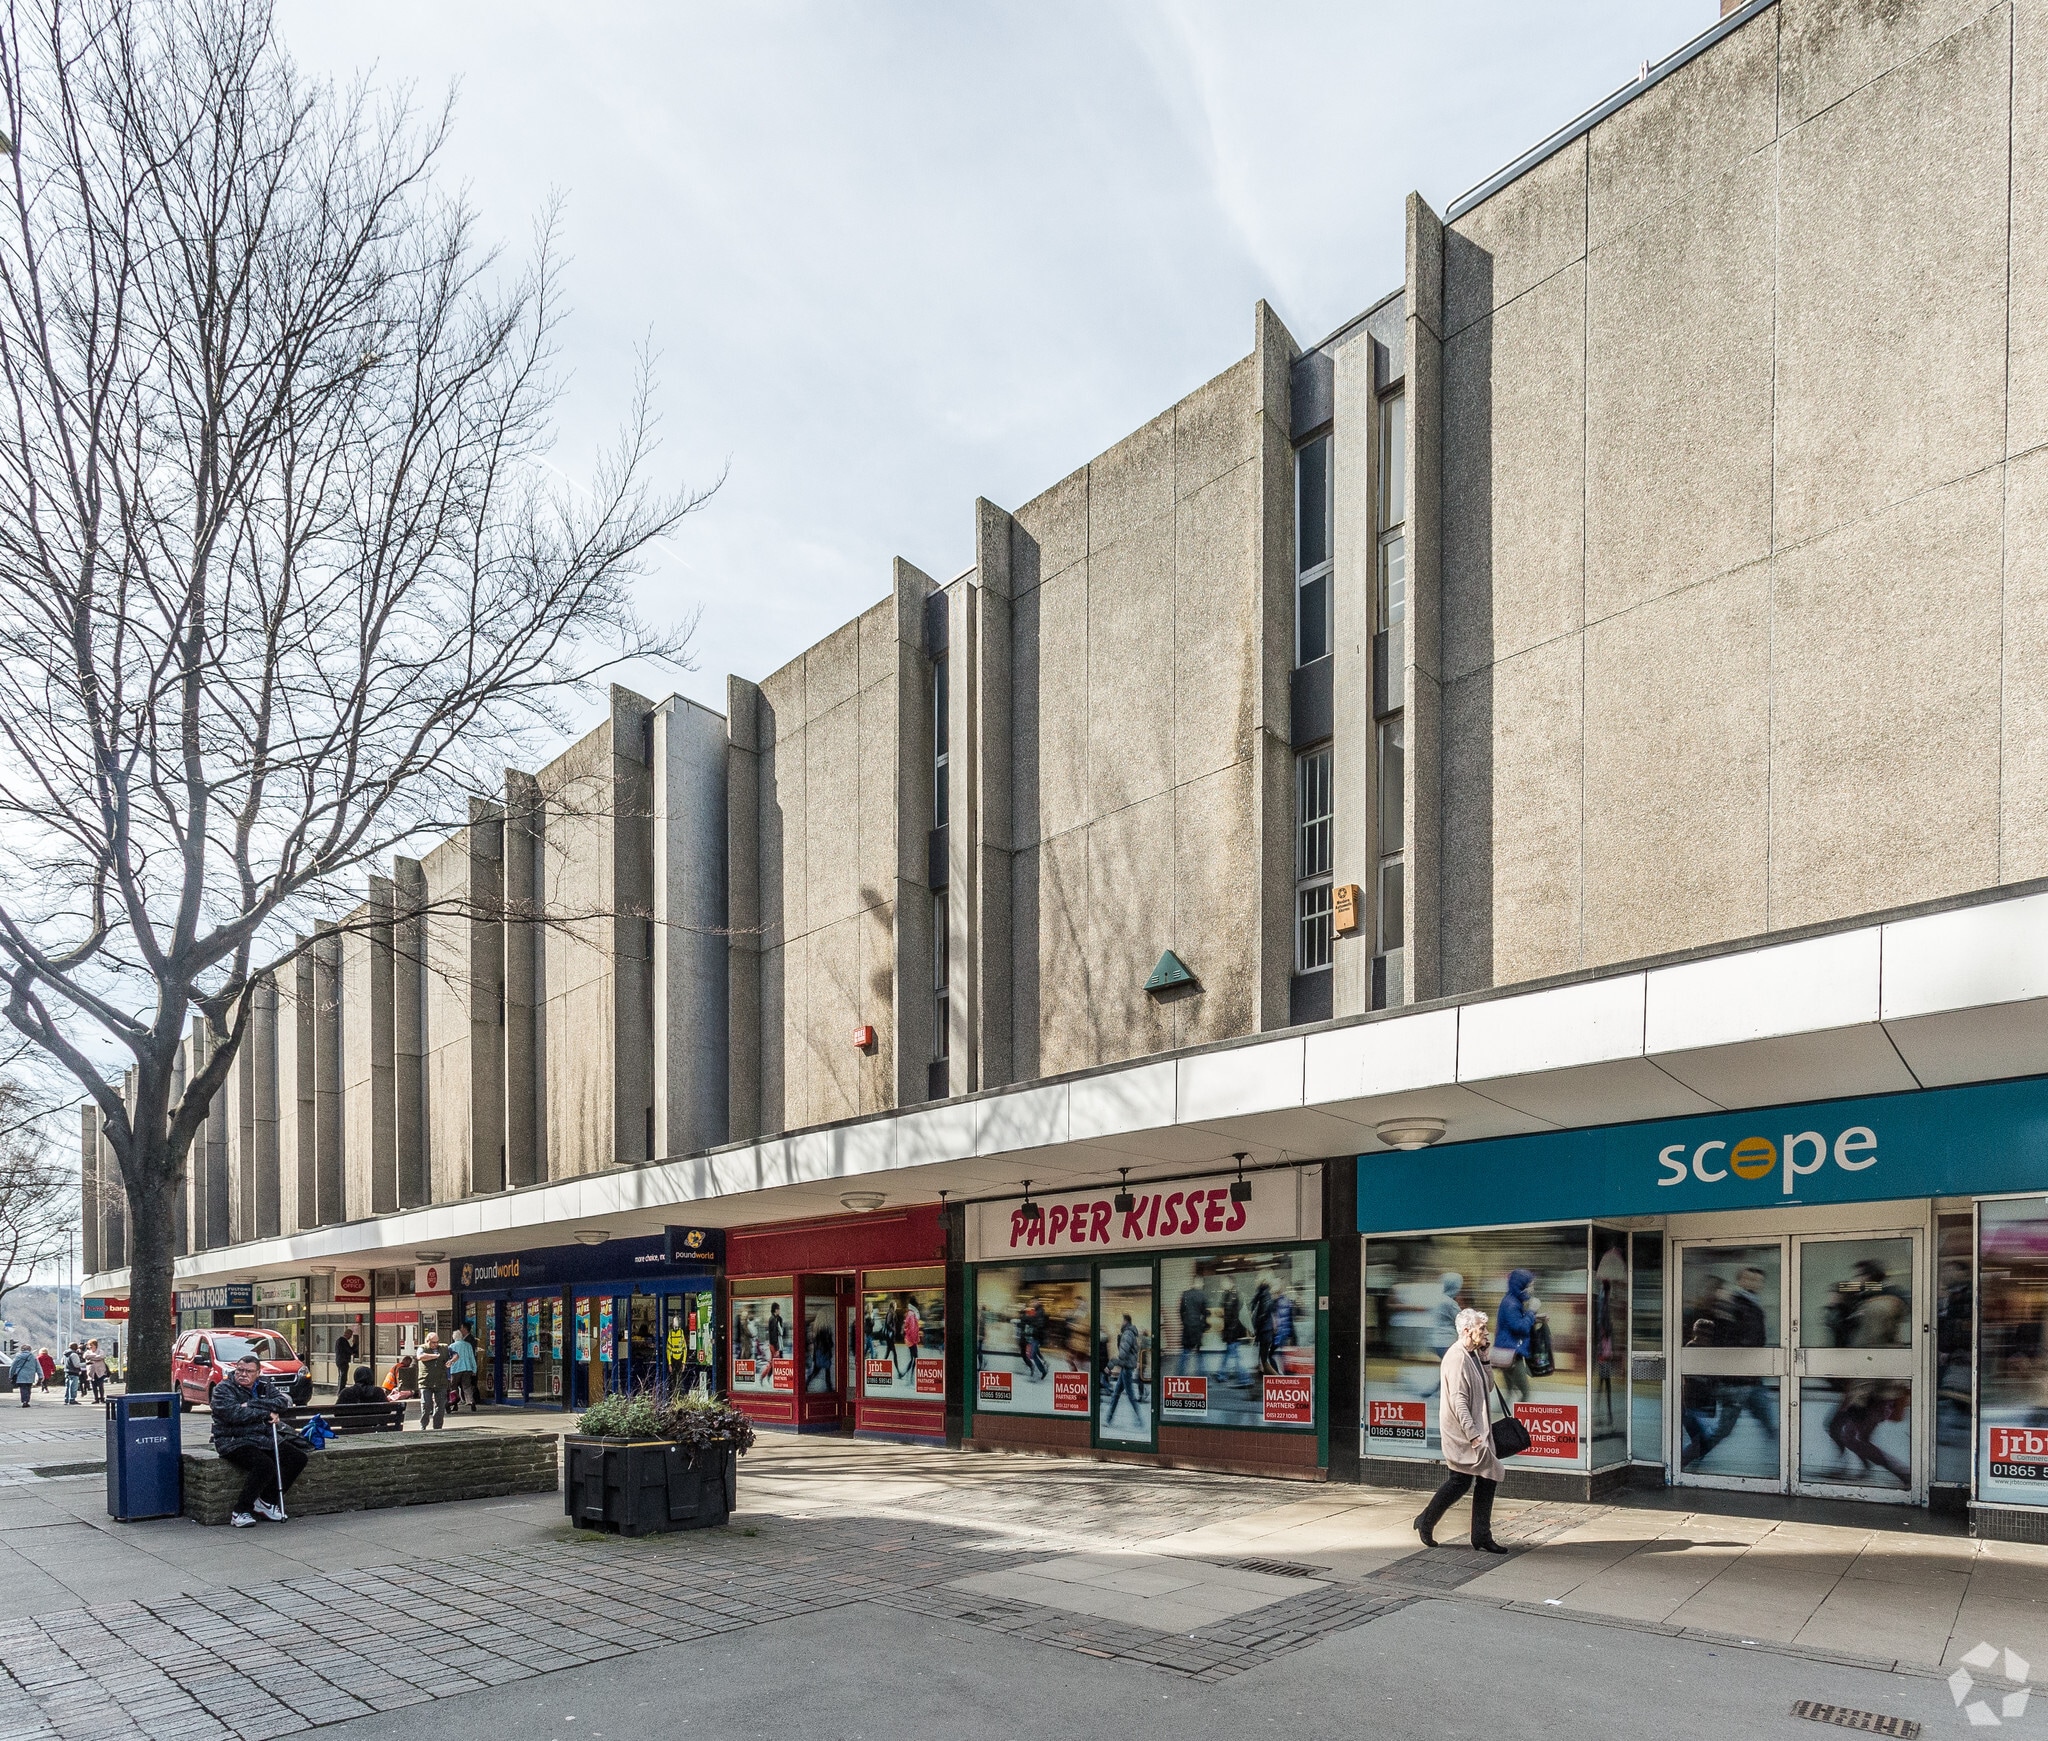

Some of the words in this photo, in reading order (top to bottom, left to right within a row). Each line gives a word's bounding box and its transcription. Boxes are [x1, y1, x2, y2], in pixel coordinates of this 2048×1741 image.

[1657, 1126, 1878, 1195] scope
[1009, 1201, 1113, 1248] PAPER
[1121, 1188, 1247, 1241] KISSES
[675, 1251, 714, 1260] poundworld
[474, 1259, 520, 1284] poundworld
[180, 1289, 206, 1309] FULTONS
[774, 1367, 793, 1376] MASON
[868, 1360, 883, 1375] jrbt
[917, 1368, 943, 1378] MASON
[982, 1372, 1000, 1388] jrbt
[1055, 1383, 1087, 1394] MASON
[1167, 1378, 1190, 1396] jrbt
[1265, 1389, 1310, 1402] MASON
[1165, 1399, 1183, 1408] 01865
[1184, 1400, 1206, 1409] 595143
[1529, 1406, 1563, 1415] ENQUIRIES
[1373, 1402, 1404, 1422] jrbt
[1371, 1426, 1394, 1436] 01865
[1396, 1428, 1425, 1438] 595143
[1518, 1418, 1576, 1435] MASON
[136, 1436, 167, 1444] LITTER
[1529, 1434, 1576, 1444] TNERS.COM
[1543, 1447, 1560, 1455] 1008
[1993, 1463, 2036, 1477] 01865
